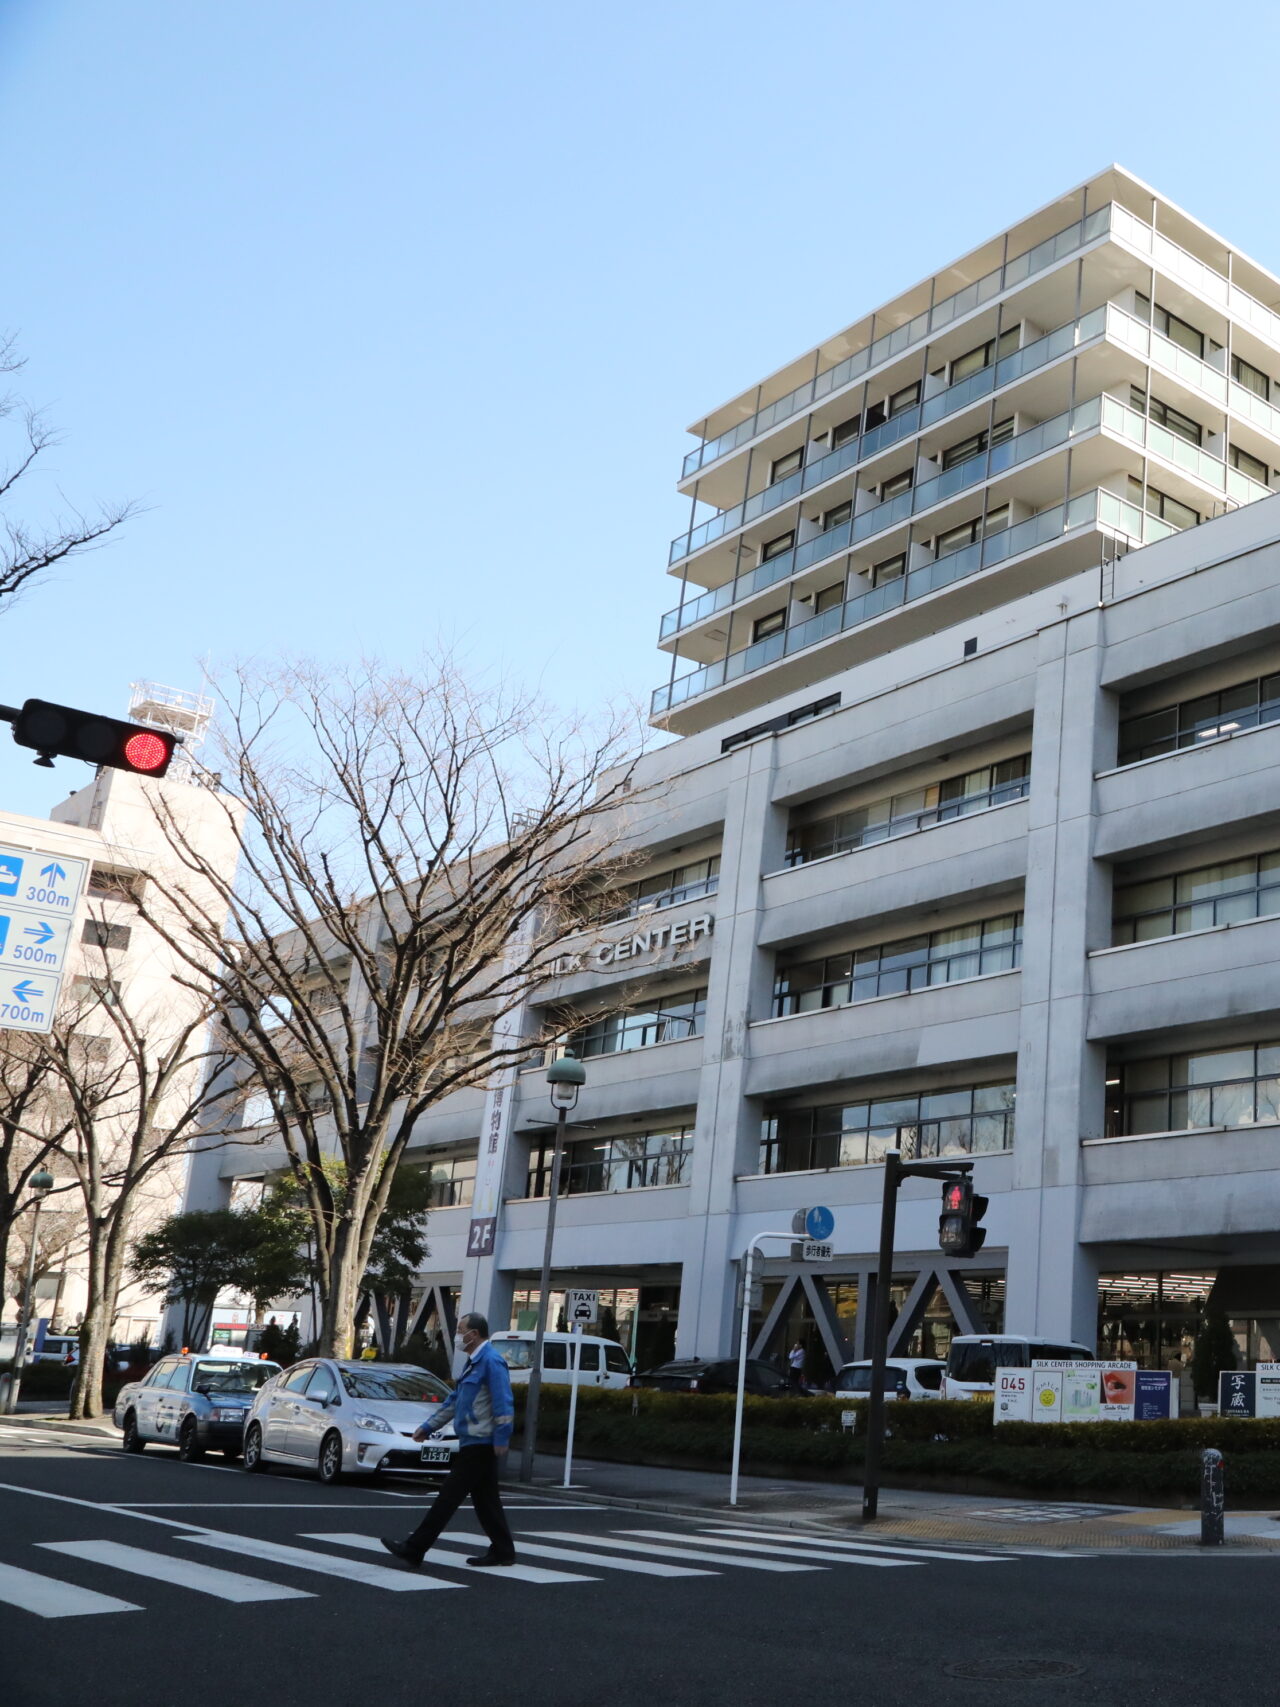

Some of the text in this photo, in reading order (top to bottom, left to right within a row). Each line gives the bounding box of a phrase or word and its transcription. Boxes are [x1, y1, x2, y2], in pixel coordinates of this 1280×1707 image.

[25, 886, 70, 907] 300m
[596, 914, 714, 966] CENTER
[13, 944, 57, 965] 500m
[0, 1003, 45, 1023] 700m
[470, 1223, 492, 1249] 2F
[573, 1293, 596, 1302] TAXI
[1001, 1377, 1025, 1391] 045
[1231, 1374, 1246, 1408] 写蔵
